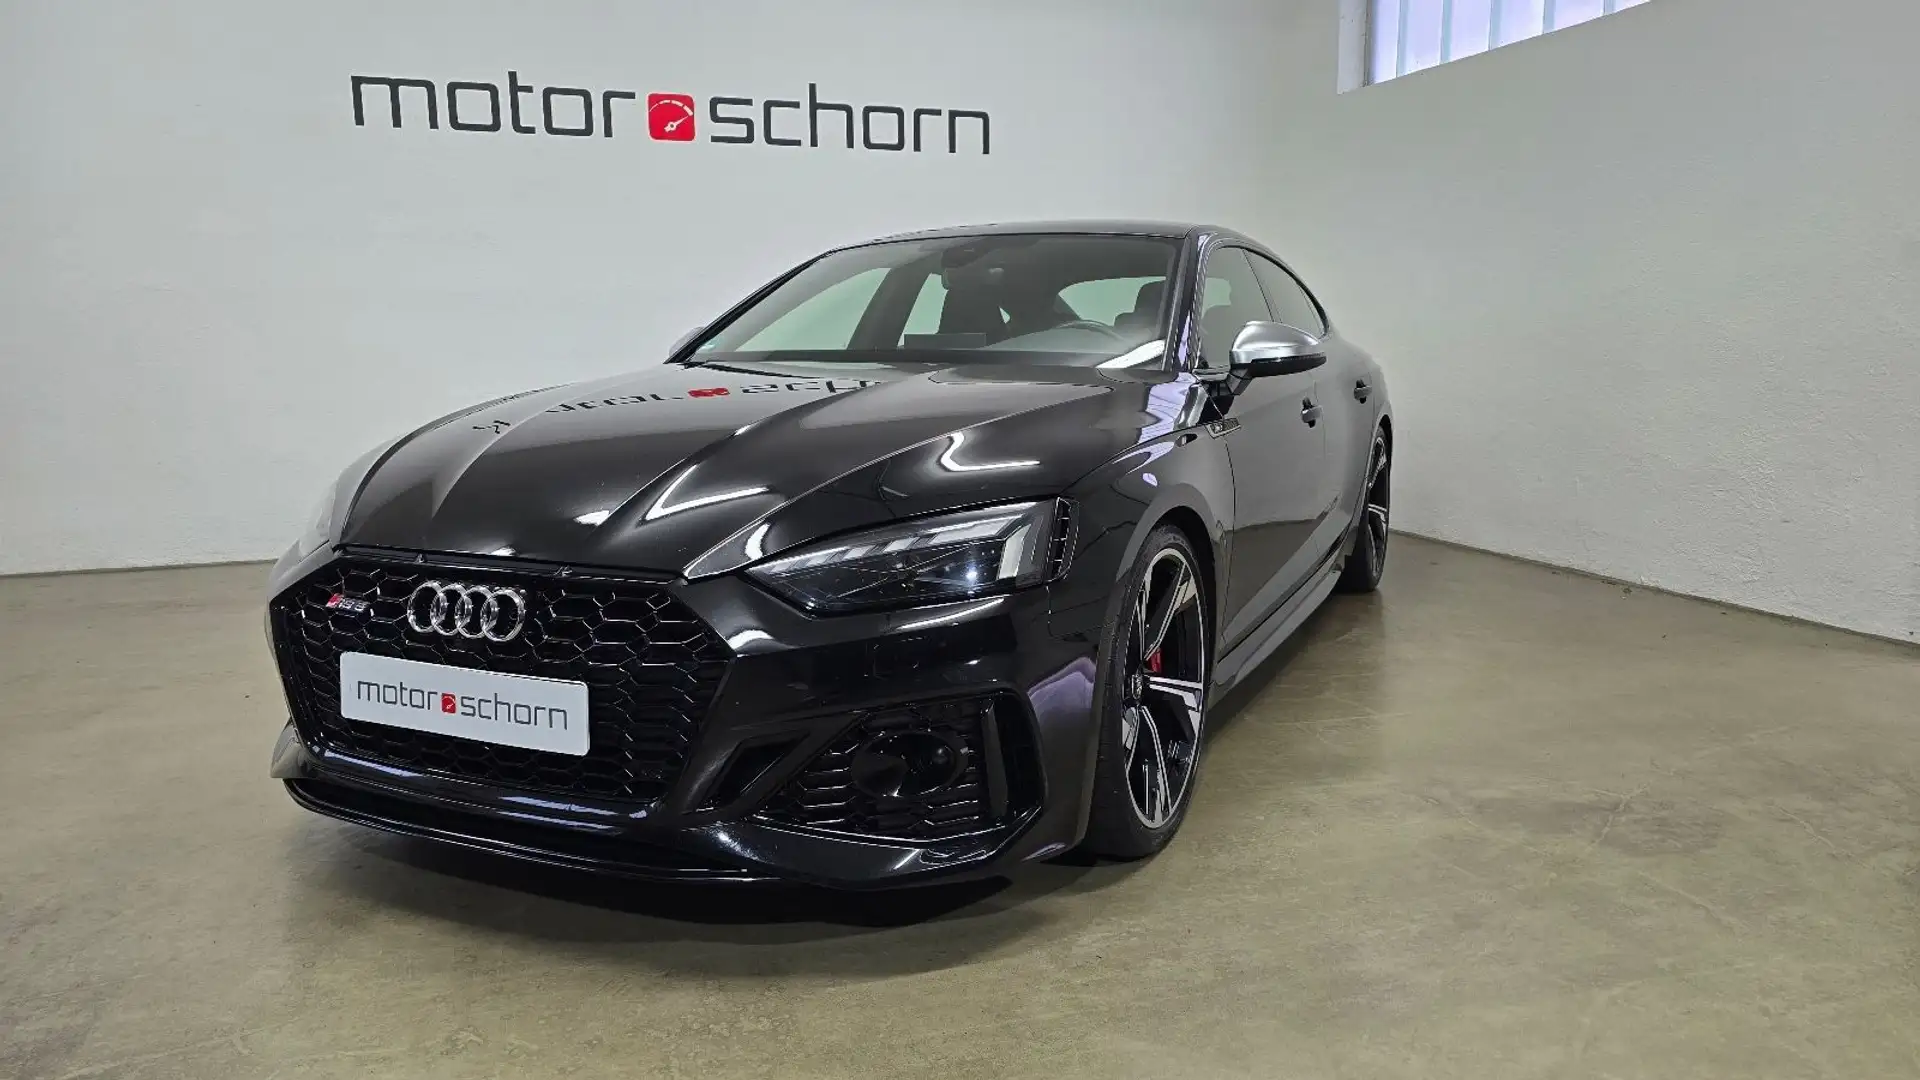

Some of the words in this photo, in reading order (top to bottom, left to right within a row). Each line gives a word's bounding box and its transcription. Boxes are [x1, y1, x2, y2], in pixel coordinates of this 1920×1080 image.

[350, 70, 636, 138] motor
[709, 82, 990, 155] schorn
[357, 681, 438, 710] motor
[460, 693, 568, 730] schorn
